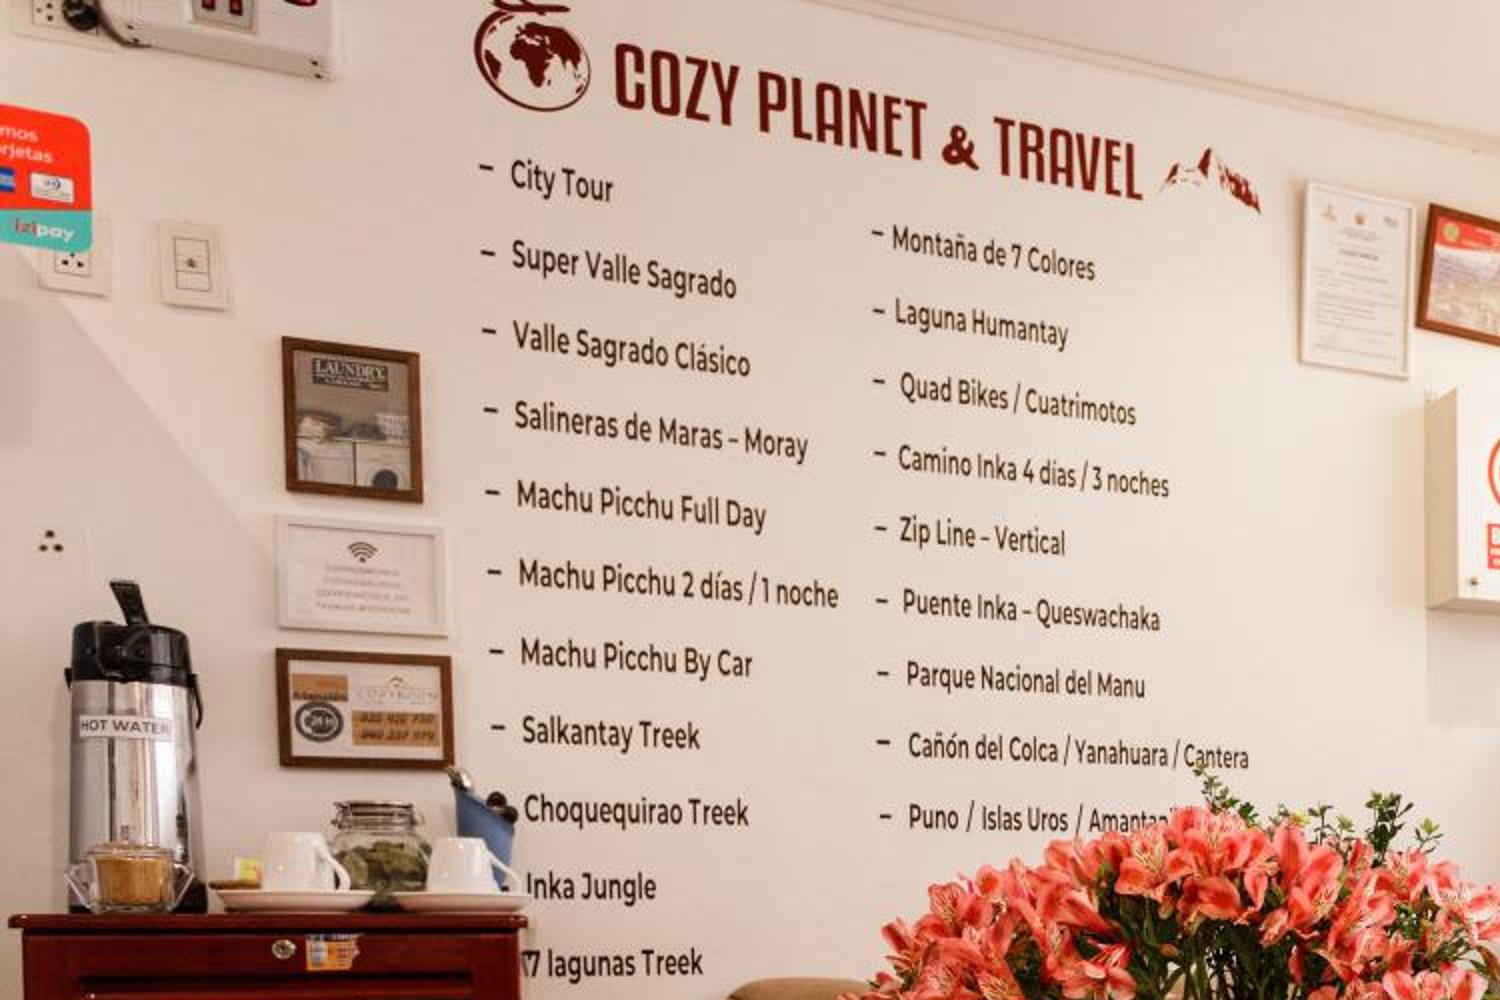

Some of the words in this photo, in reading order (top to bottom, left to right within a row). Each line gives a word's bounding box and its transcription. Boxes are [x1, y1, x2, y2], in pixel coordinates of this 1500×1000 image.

[614, 42, 741, 127] COZY
[757, 70, 928, 161] PLANET
[941, 124, 980, 172] &
[993, 115, 1144, 201] TRAVEL
[0, 143, 54, 164] rjetas
[510, 158, 556, 201] City
[561, 167, 614, 203] Tour
[15, 217, 75, 242] izipay
[511, 239, 580, 280] Super
[584, 250, 641, 286] Valle
[647, 259, 737, 300] Sagrado
[892, 224, 978, 263] Montaña
[983, 239, 1007, 268] de
[1010, 243, 1022, 269] 7
[1027, 246, 1096, 281] Colores
[895, 297, 967, 335] Laguna
[972, 309, 1069, 353] Humantay
[315, 359, 385, 380] LAUNDRY
[512, 319, 571, 355] Valle
[576, 328, 669, 368] Sagrado
[674, 341, 751, 378] Clásico
[900, 371, 952, 404] Quad
[958, 378, 1009, 410] Bikes
[1025, 388, 1137, 426] Cuatrimotos
[514, 399, 619, 439] Salineras
[624, 411, 653, 443] de
[659, 416, 723, 450] Maras
[744, 426, 809, 466] Moray
[898, 444, 972, 477] Camino
[977, 453, 1017, 482] Inka
[1022, 458, 1035, 484] 4
[1092, 465, 1103, 491] 3
[1107, 470, 1169, 498] noches
[517, 479, 593, 513] Machu
[600, 485, 674, 521] Picchu
[681, 495, 720, 525] Full
[726, 499, 767, 536] Day
[899, 514, 931, 550] Zip
[936, 517, 977, 548] Line
[994, 525, 1065, 556] Vertical
[519, 558, 595, 591] Machu
[602, 562, 676, 597] Picchu
[681, 570, 695, 599] 2
[699, 570, 744, 602] días
[761, 576, 769, 604] 1
[776, 579, 839, 609] noche
[903, 587, 972, 619] Puente
[977, 594, 1017, 621] Inka
[1035, 598, 1161, 631] Queswachaka
[521, 636, 597, 669] Machu
[603, 639, 677, 673] Picchu
[684, 646, 712, 683] By
[717, 648, 753, 678] Car
[907, 660, 976, 695] Parque
[980, 664, 1060, 694] Nacional
[1065, 669, 1093, 696] del
[1097, 671, 1145, 699] Manu
[81, 719, 108, 732] HOT
[112, 719, 169, 735] WATER
[522, 714, 634, 755] Salkantay
[638, 720, 701, 750] Treek
[908, 731, 970, 760] Cañón
[975, 734, 1003, 761] del
[1009, 735, 1059, 763] Colca
[1074, 739, 1169, 767] Yanahuara
[1183, 743, 1249, 769] Cantera
[523, 793, 683, 831] Choquequirao
[687, 797, 749, 827] Treek
[909, 803, 959, 831] Puno
[982, 804, 1023, 832] Islas
[1027, 807, 1069, 833] Uros
[526, 870, 575, 900] Inka
[580, 871, 657, 908] Jungle
[547, 948, 637, 985] lagunas
[640, 946, 704, 977] Treek
